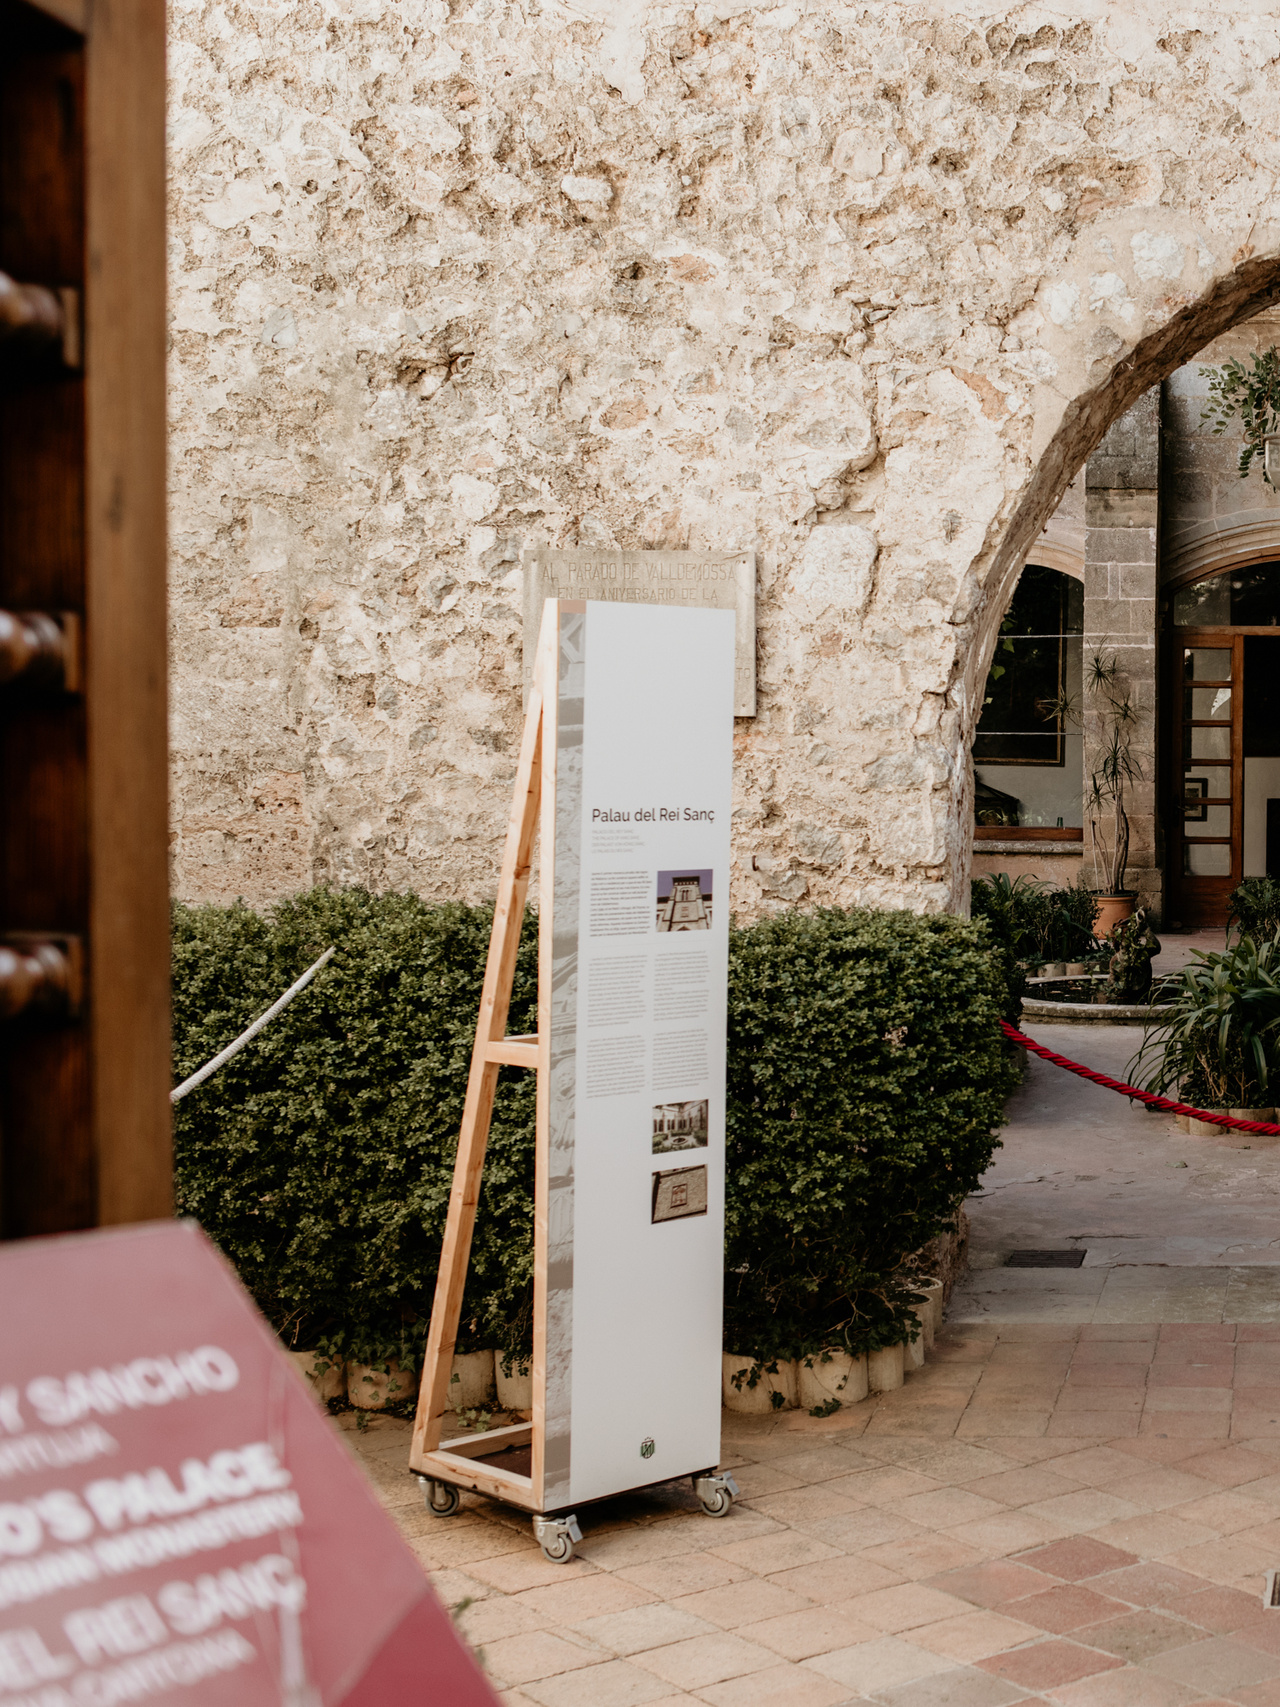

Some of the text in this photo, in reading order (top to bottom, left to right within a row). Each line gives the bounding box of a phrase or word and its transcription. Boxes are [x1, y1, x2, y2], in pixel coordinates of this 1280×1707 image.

[623, 562, 640, 580] DE
[592, 807, 715, 824] Palau del Rei Sanç
[26, 1346, 239, 1427] SANCHO
[84, 1441, 292, 1531] PALACE
